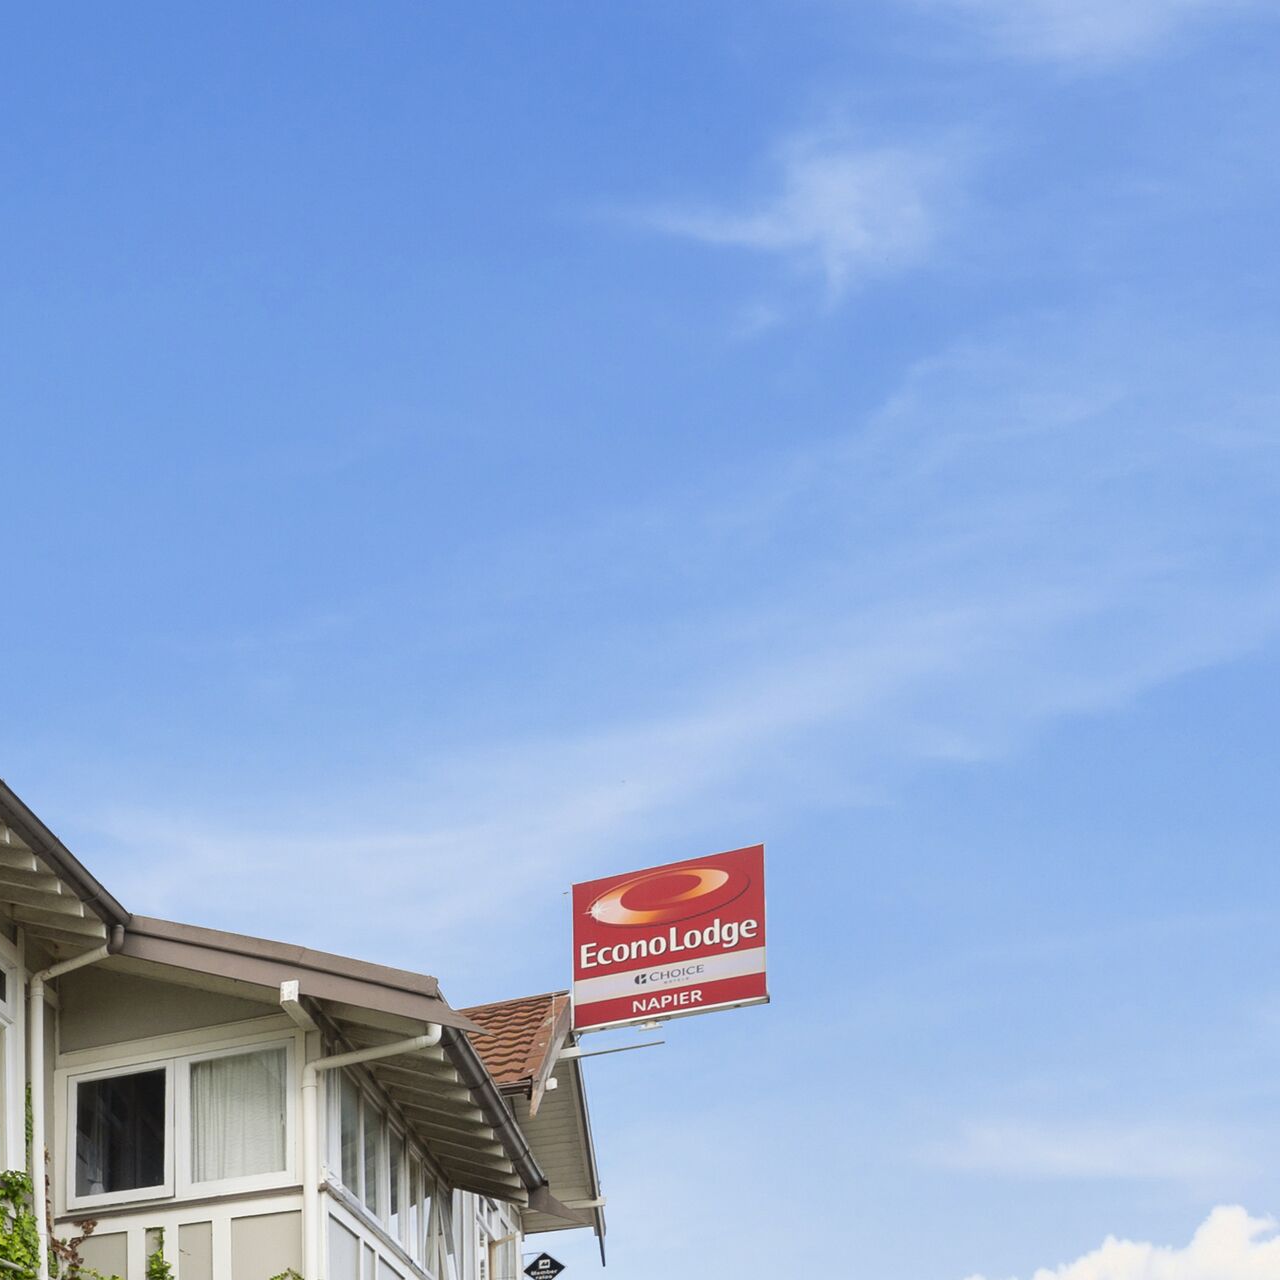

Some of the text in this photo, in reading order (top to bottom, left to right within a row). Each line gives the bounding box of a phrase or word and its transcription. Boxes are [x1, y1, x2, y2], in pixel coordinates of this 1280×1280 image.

[580, 918, 758, 969] EconoLodge
[649, 964, 705, 982] CHOICE
[632, 989, 703, 1013] NAPIER
